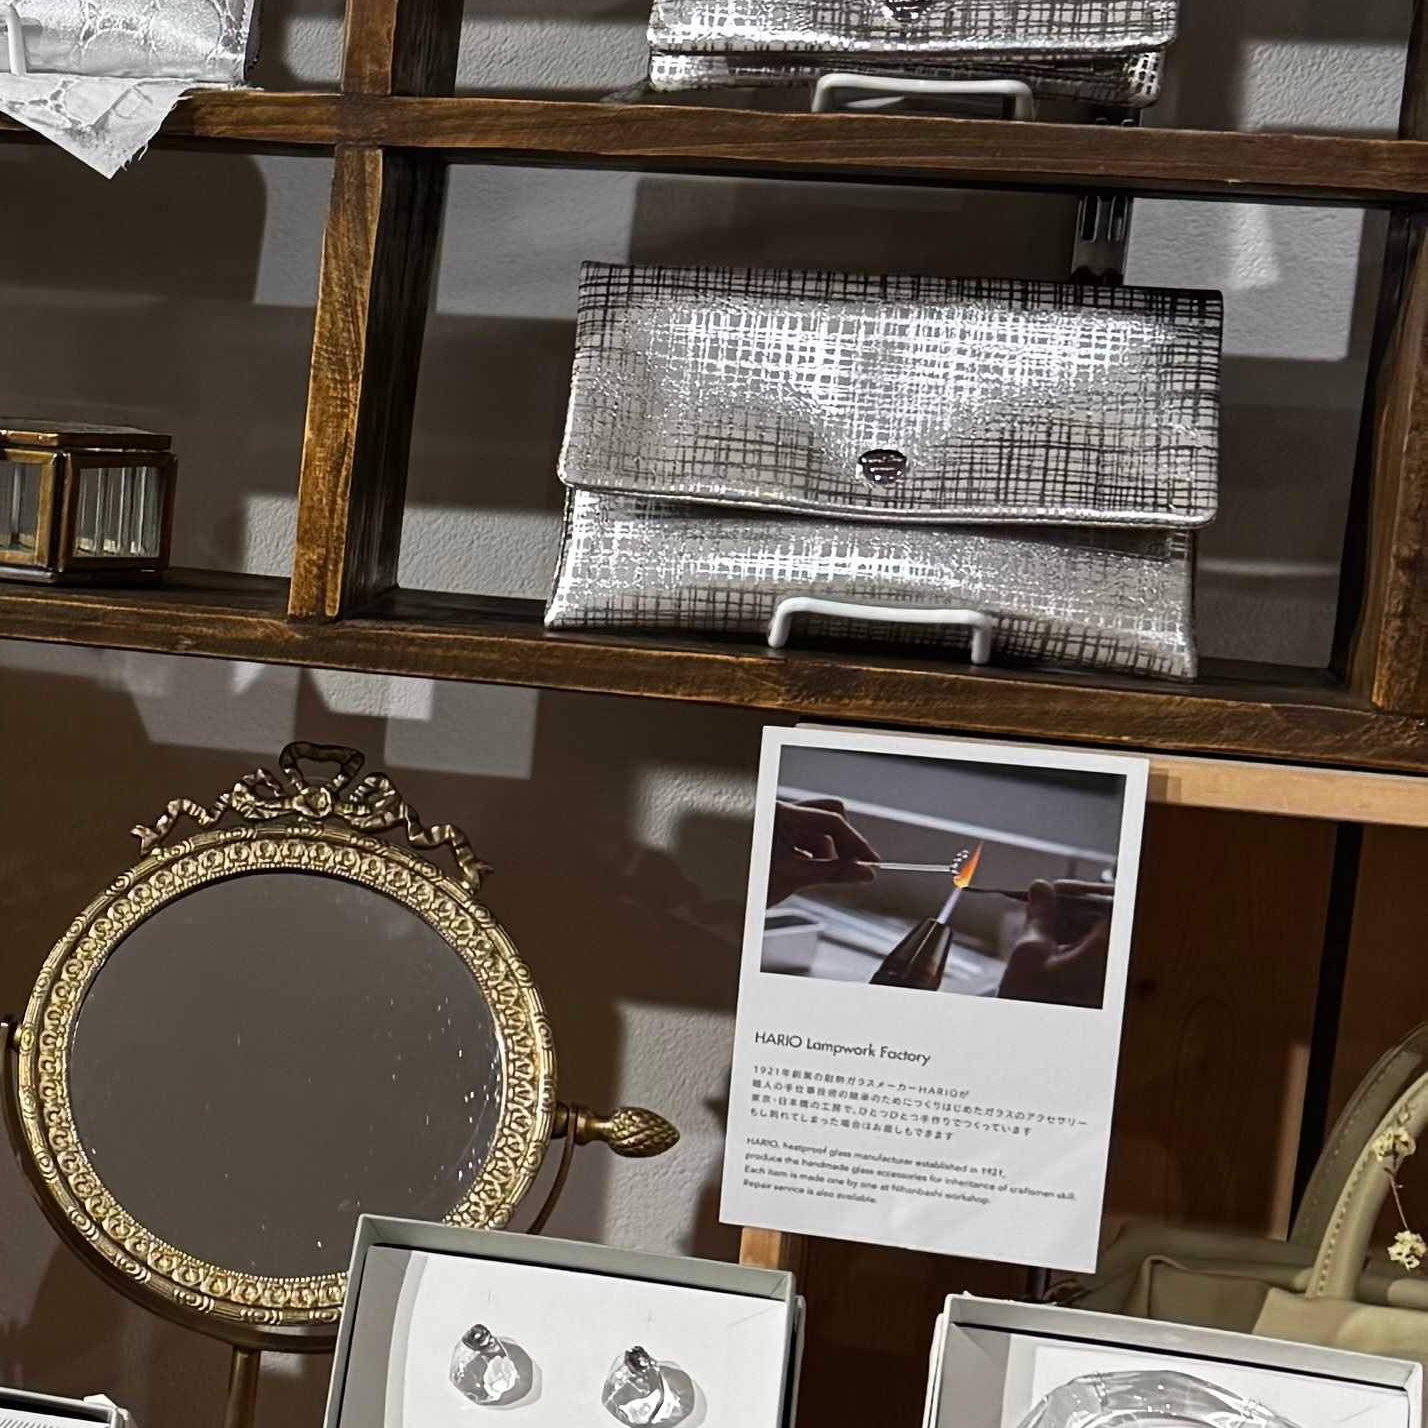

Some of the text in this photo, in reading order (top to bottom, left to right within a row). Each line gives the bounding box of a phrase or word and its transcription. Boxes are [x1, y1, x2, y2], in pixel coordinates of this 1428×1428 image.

[754, 1031, 931, 1066] HARIO Lampwork Factory
[743, 1179, 772, 1190] Repair
[773, 1184, 805, 1195] service
[744, 1164, 766, 1175] Each
[799, 1172, 825, 1183] made
[846, 1178, 858, 1190] by
[784, 1156, 799, 1165] the
[801, 1158, 850, 1172] handmade
[851, 1164, 874, 1176] glass
[997, 1183, 1008, 1192] of
